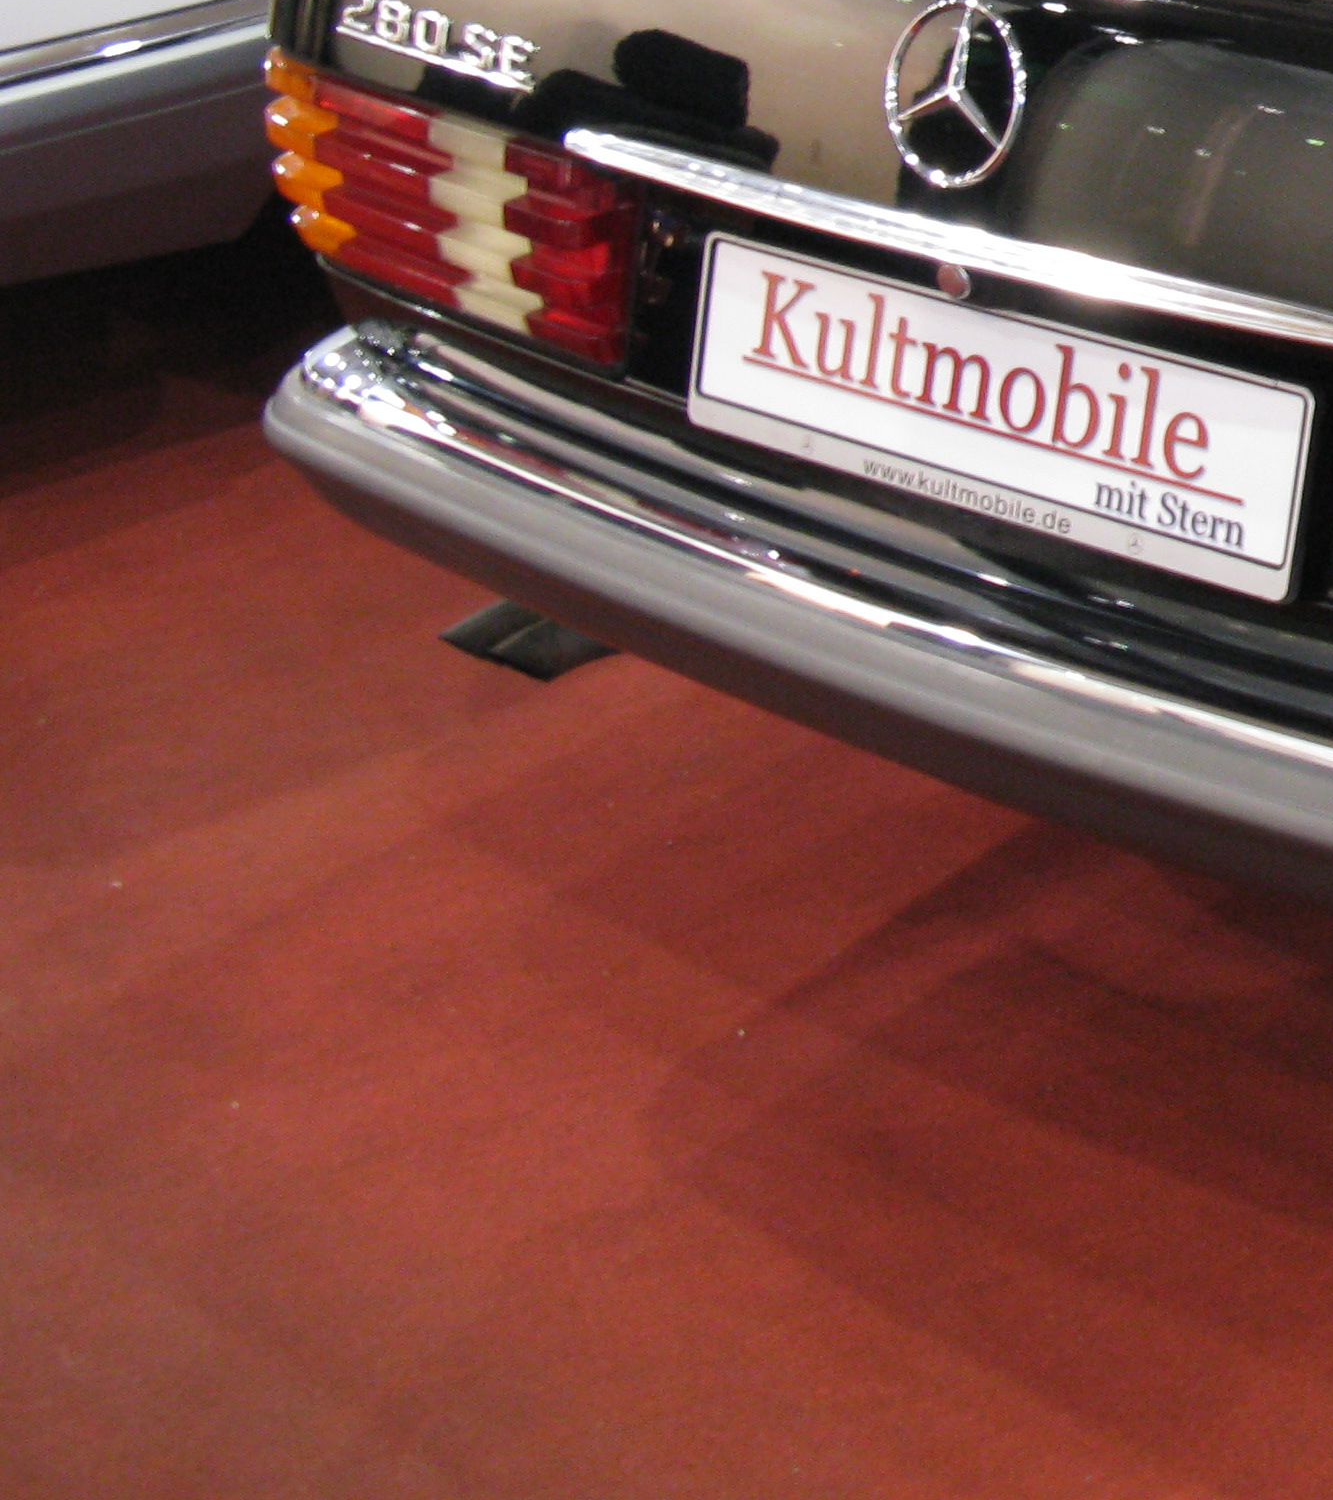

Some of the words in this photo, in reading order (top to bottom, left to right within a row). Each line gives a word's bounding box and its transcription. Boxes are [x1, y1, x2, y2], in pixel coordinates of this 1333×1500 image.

[458, 23, 541, 86] SE
[752, 270, 1209, 480] Kultmobile
[862, 458, 1072, 534] www.kultmobile.de
[1094, 480, 1148, 522] mit
[1157, 486, 1245, 548] Stern
